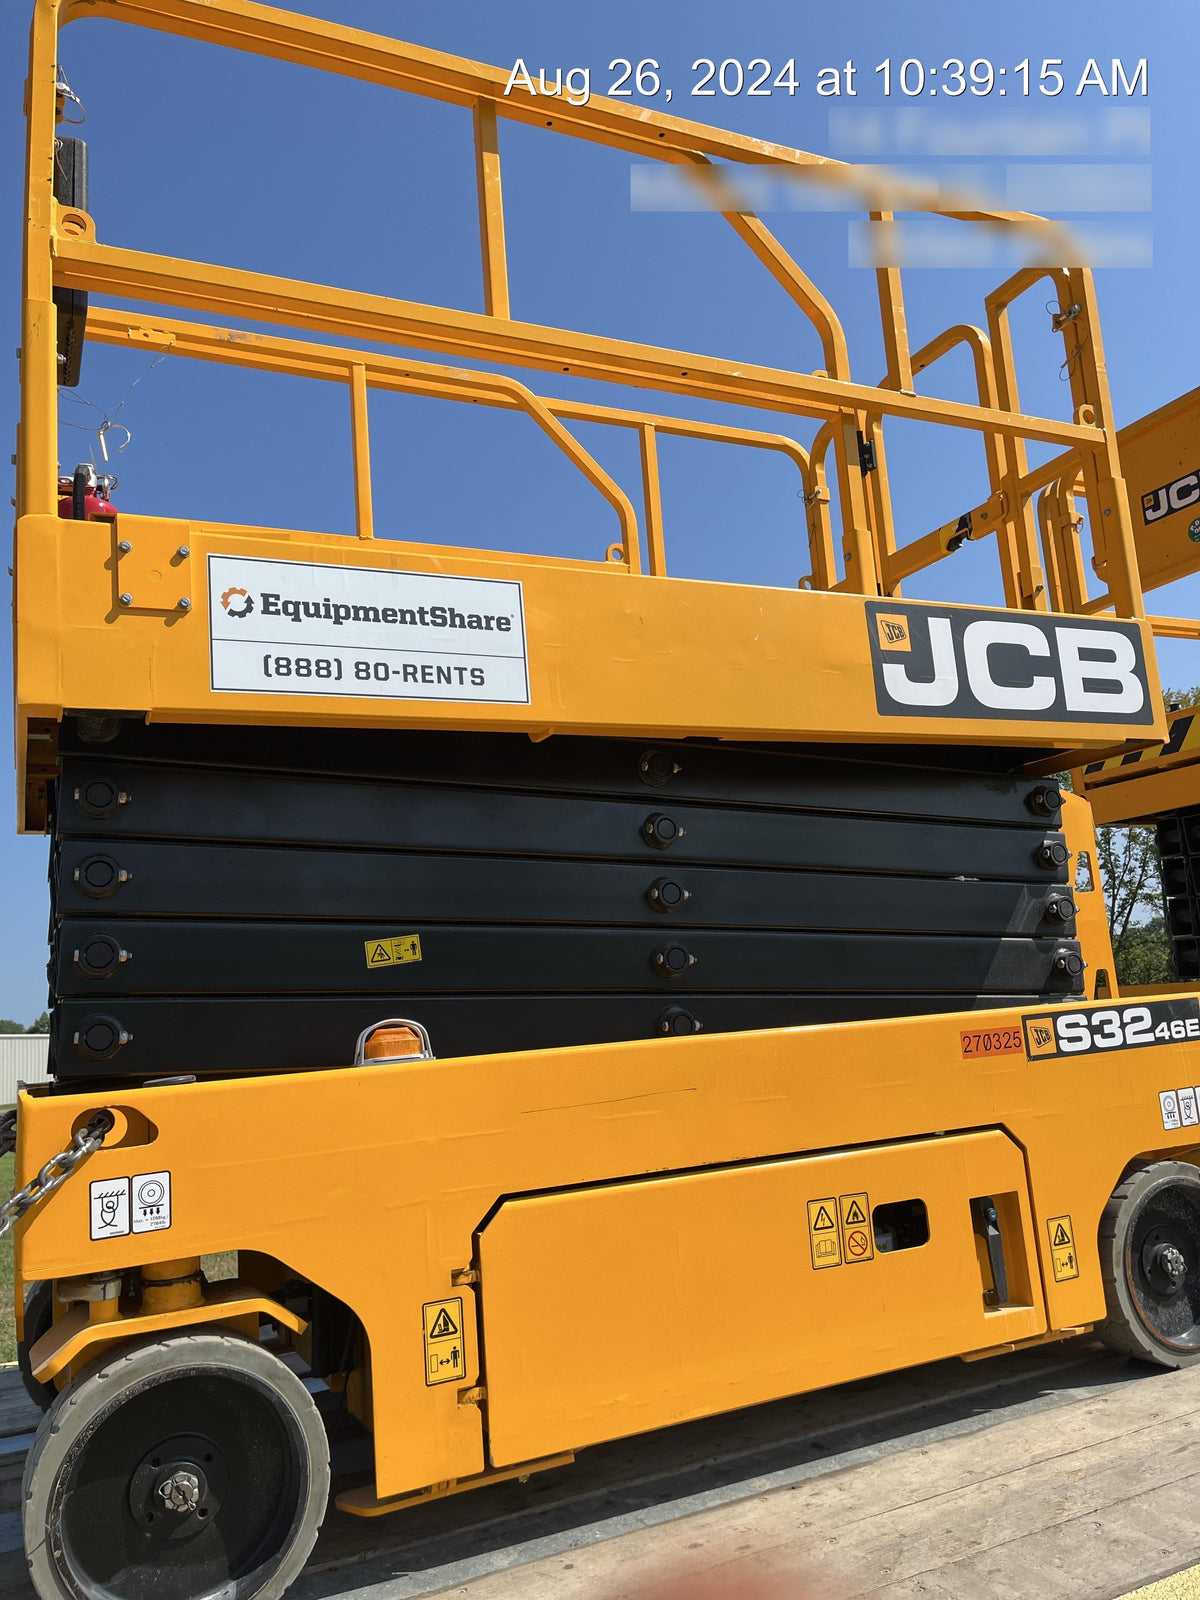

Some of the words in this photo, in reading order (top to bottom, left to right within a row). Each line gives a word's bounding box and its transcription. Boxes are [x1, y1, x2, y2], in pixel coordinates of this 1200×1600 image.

[1145, 475, 1200, 521] JC
[260, 592, 512, 632] EquipmentShare
[885, 622, 905, 641] JCB
[263, 654, 343, 681] (888)
[354, 662, 486, 686] 80-RENTS
[882, 616, 1144, 714] JCB
[962, 1030, 1022, 1053] 270325
[1033, 1028, 1051, 1046] JCB
